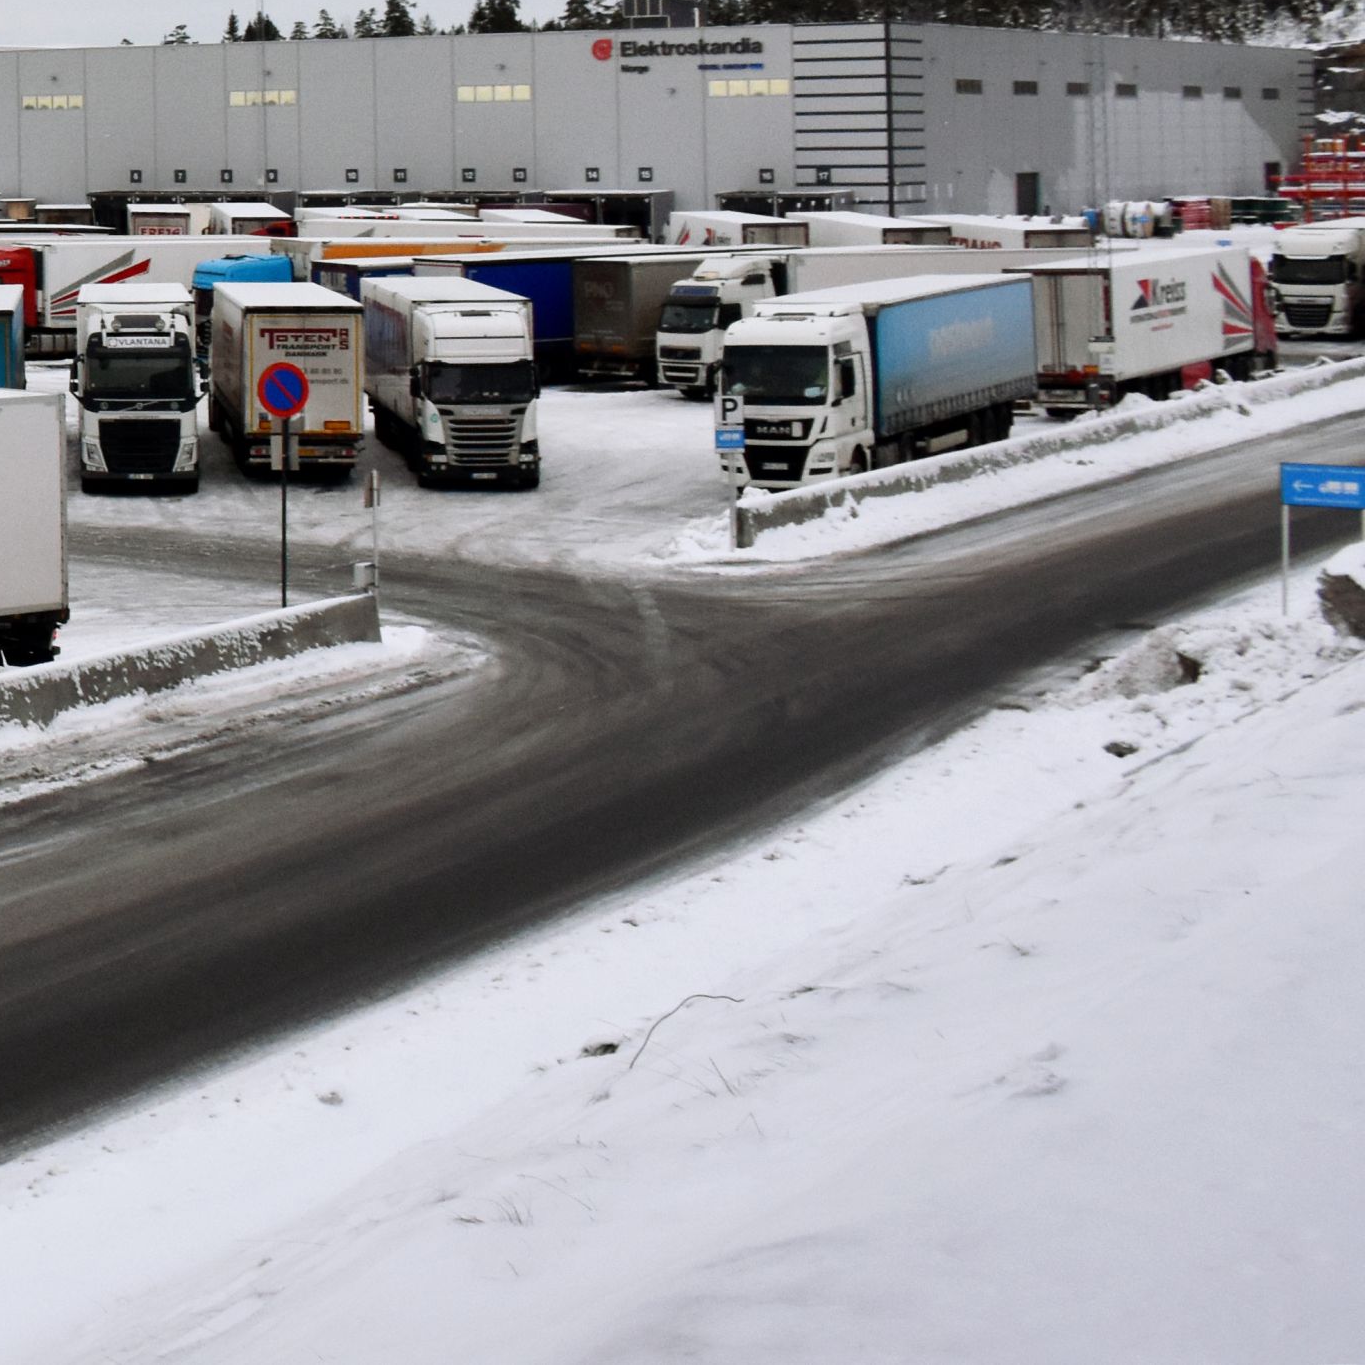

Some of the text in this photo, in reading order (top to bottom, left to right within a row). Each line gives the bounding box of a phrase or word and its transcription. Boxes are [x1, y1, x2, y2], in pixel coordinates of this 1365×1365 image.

[620, 38, 763, 57] Elektroskandia
[620, 64, 650, 74] Norge
[119, 337, 168, 346] VLANTANA
[260, 329, 337, 350] TOTEN
[277, 343, 337, 351] TRANSPORT
[722, 398, 738, 421] P
[756, 426, 791, 434] MAN
